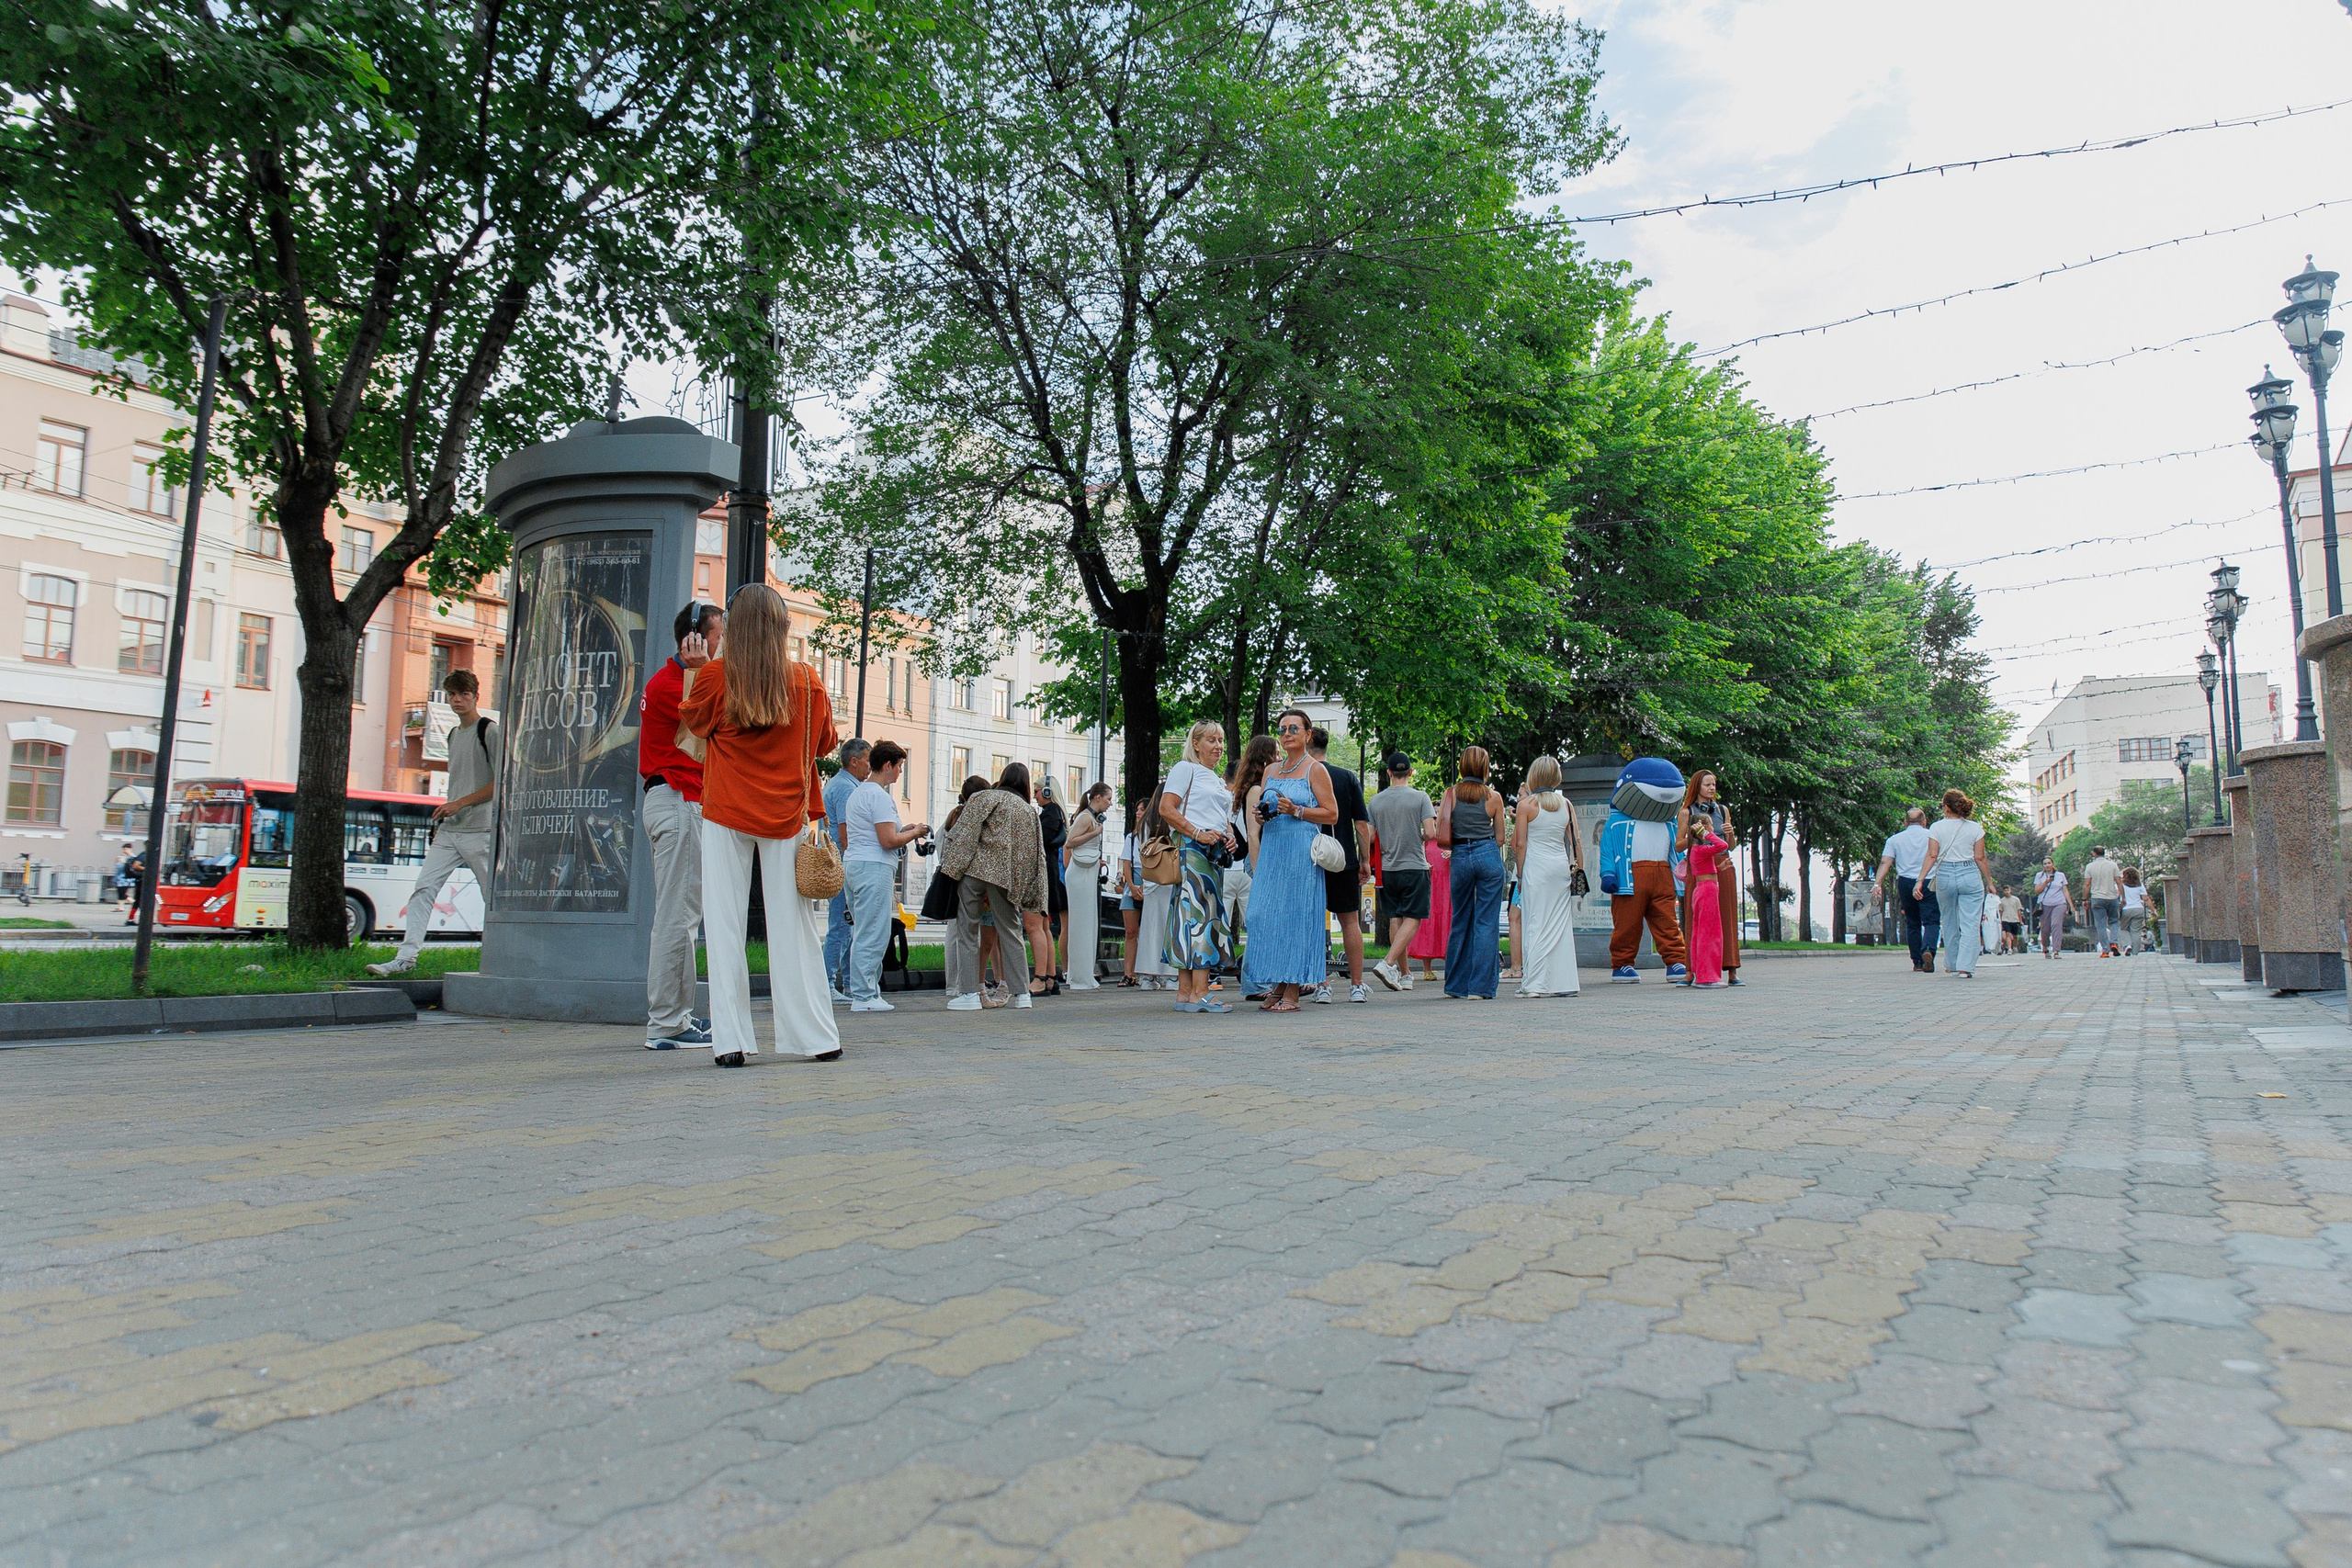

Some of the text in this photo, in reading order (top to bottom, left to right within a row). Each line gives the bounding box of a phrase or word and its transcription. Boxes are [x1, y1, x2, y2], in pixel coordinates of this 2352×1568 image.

[606, 557, 640, 565] 565-60-61
[521, 809, 575, 835] КЛЮЧЕЙ
[574, 888, 619, 897] БАТАРЕЙКИ
